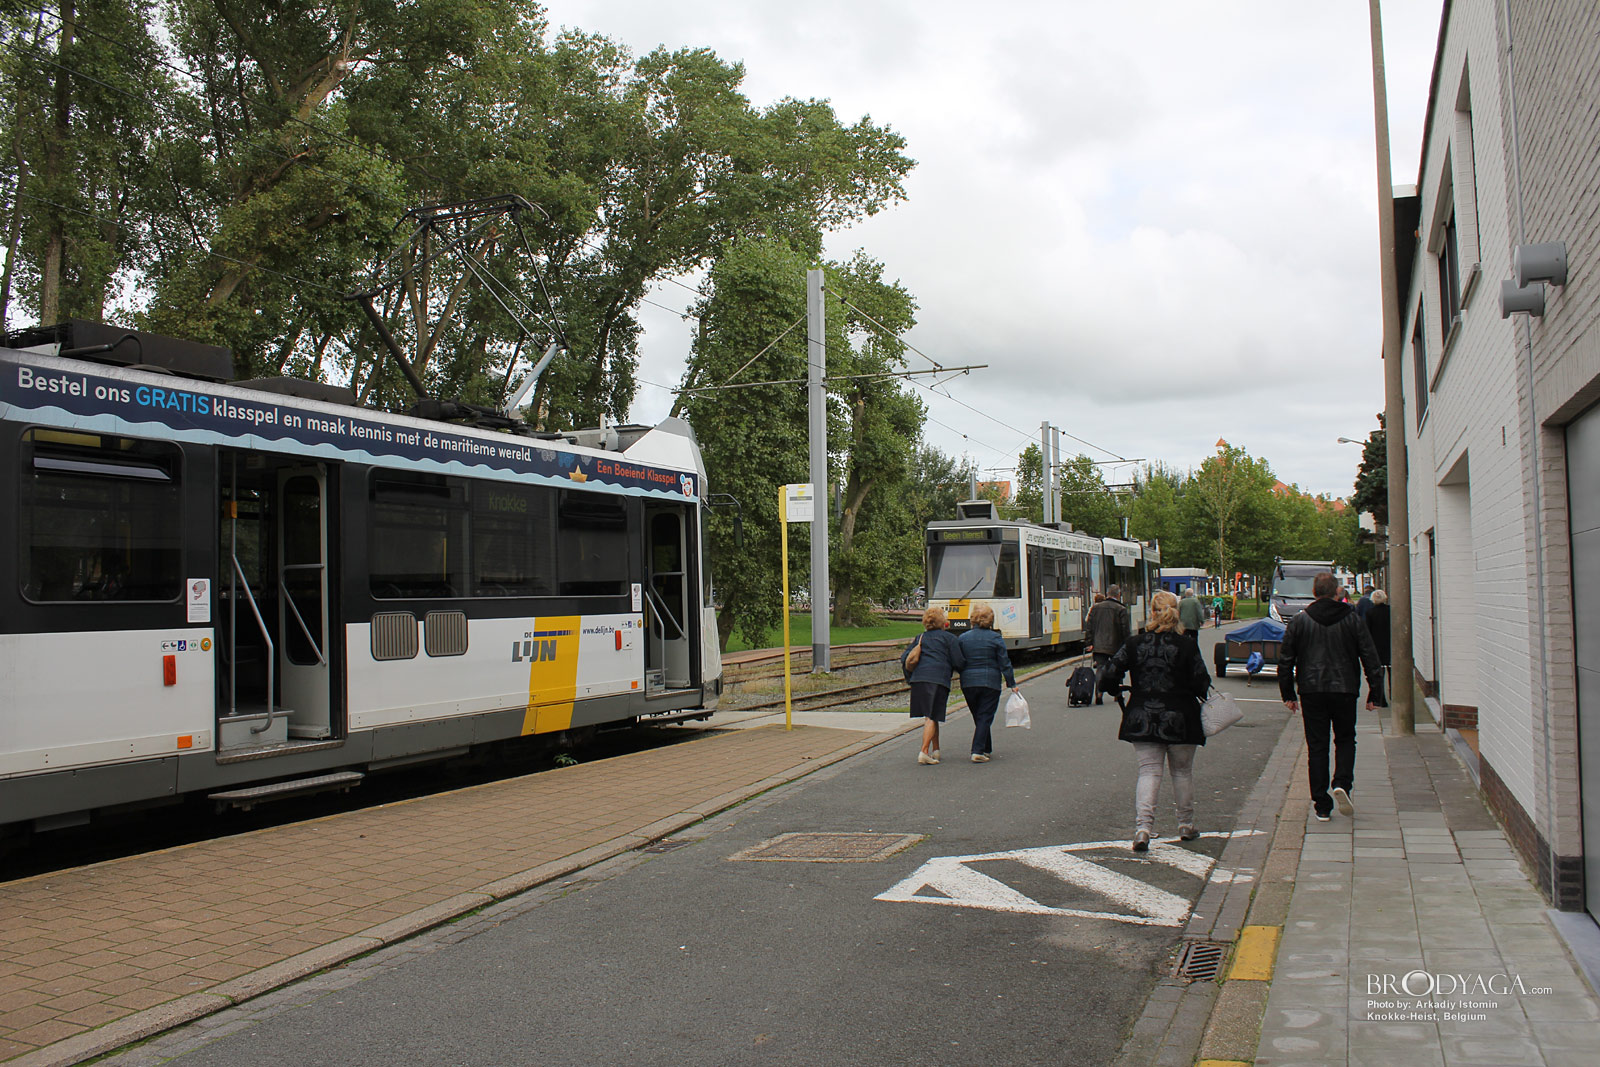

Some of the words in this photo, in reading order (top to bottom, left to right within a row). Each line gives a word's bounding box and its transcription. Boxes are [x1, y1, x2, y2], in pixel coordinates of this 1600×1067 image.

[17, 366, 87, 397] Bestel
[94, 384, 131, 404] ons
[135, 386, 210, 415] GRATIS
[213, 397, 278, 426] klasspel
[283, 412, 302, 428] en
[307, 416, 346, 435] maak
[350, 420, 393, 442] kennis
[396, 431, 421, 448] met
[423, 433, 439, 450] de
[441, 436, 496, 457] maritieme
[498, 446, 532, 462] wereld.
[597, 460, 612, 476] Een
[614, 463, 646, 481] Boeiend
[647, 467, 676, 487] Klasspel
[488, 489, 528, 513] Knokke
[582, 626, 615, 636] www.delijn.be
[511, 639, 557, 663] LIJN
